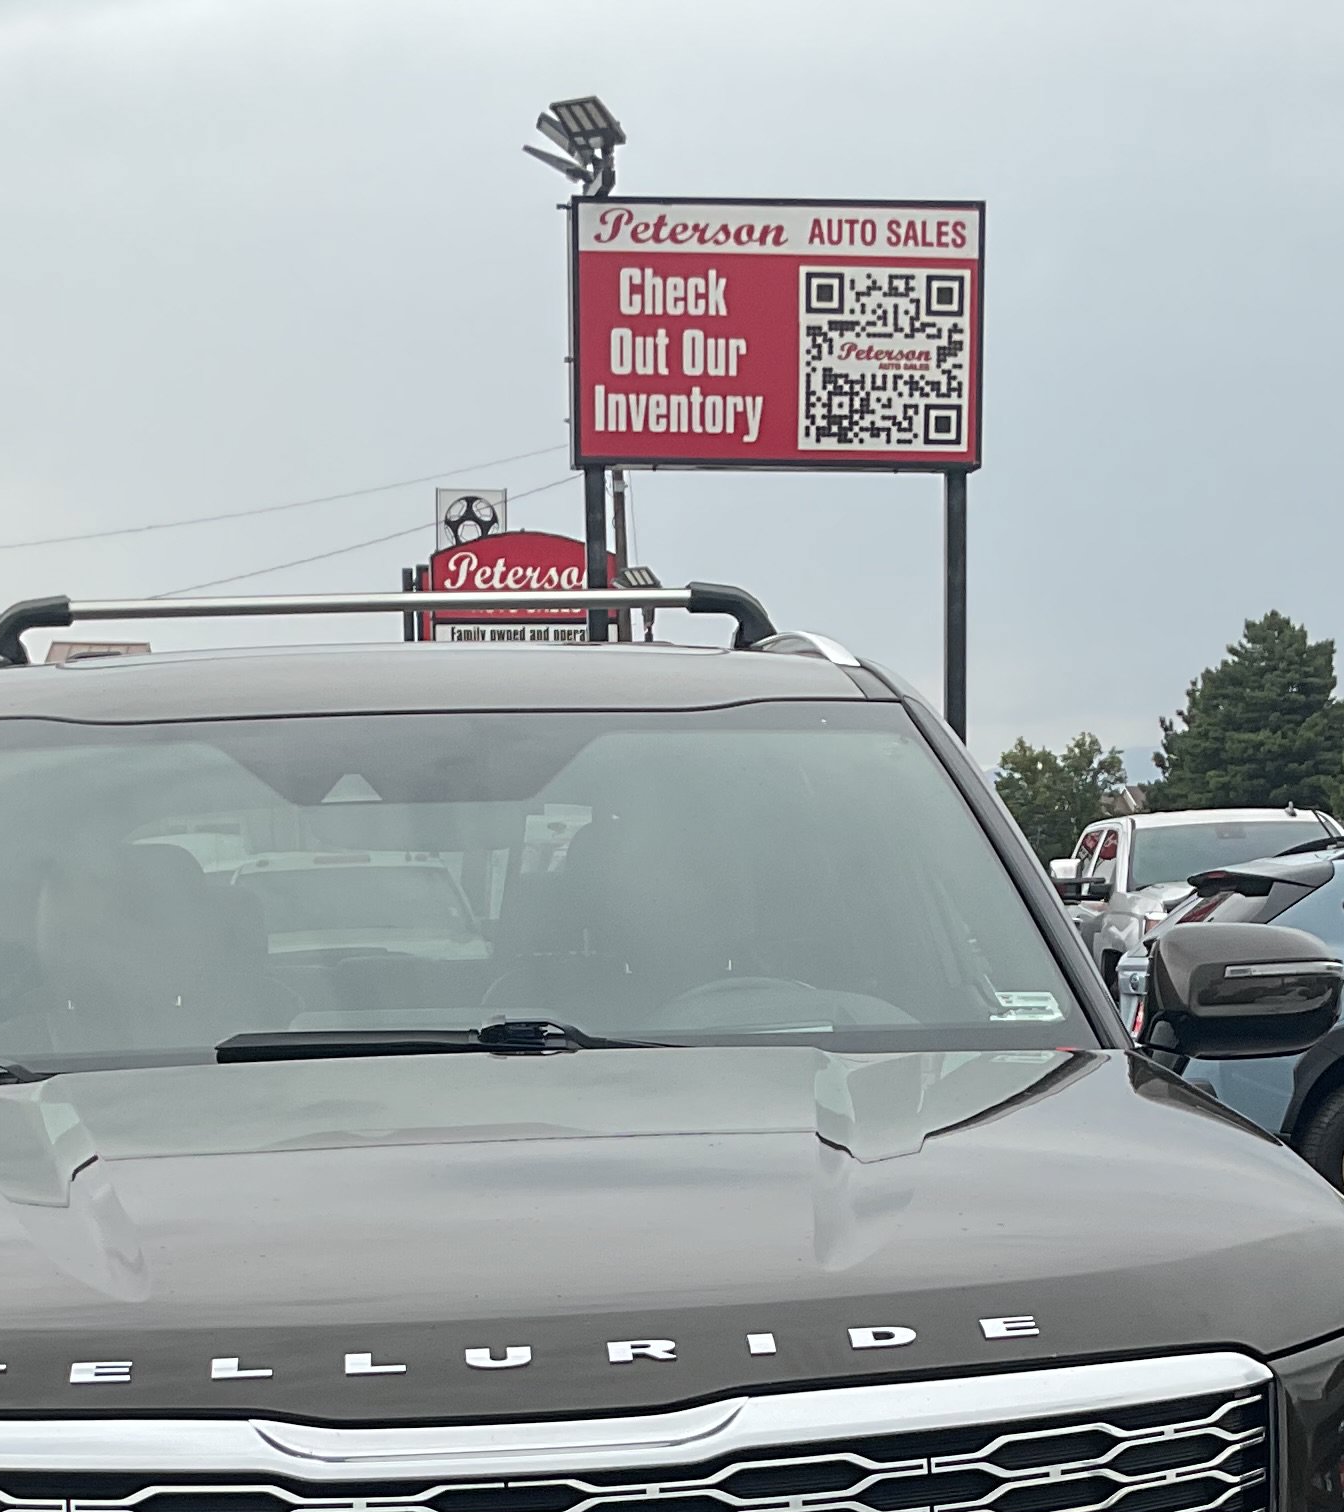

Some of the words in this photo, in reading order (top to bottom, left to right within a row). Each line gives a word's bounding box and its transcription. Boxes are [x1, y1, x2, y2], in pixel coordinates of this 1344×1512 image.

[594, 208, 788, 247] Peterson
[808, 217, 877, 247] AUTO
[886, 219, 966, 248] SALES
[619, 267, 728, 316] Check
[610, 327, 670, 376] Out
[682, 329, 747, 377] Our
[837, 342, 932, 361] Peterson
[594, 384, 763, 443] Inventory
[530, 626, 549, 641] and
[553, 628, 585, 641] opera
